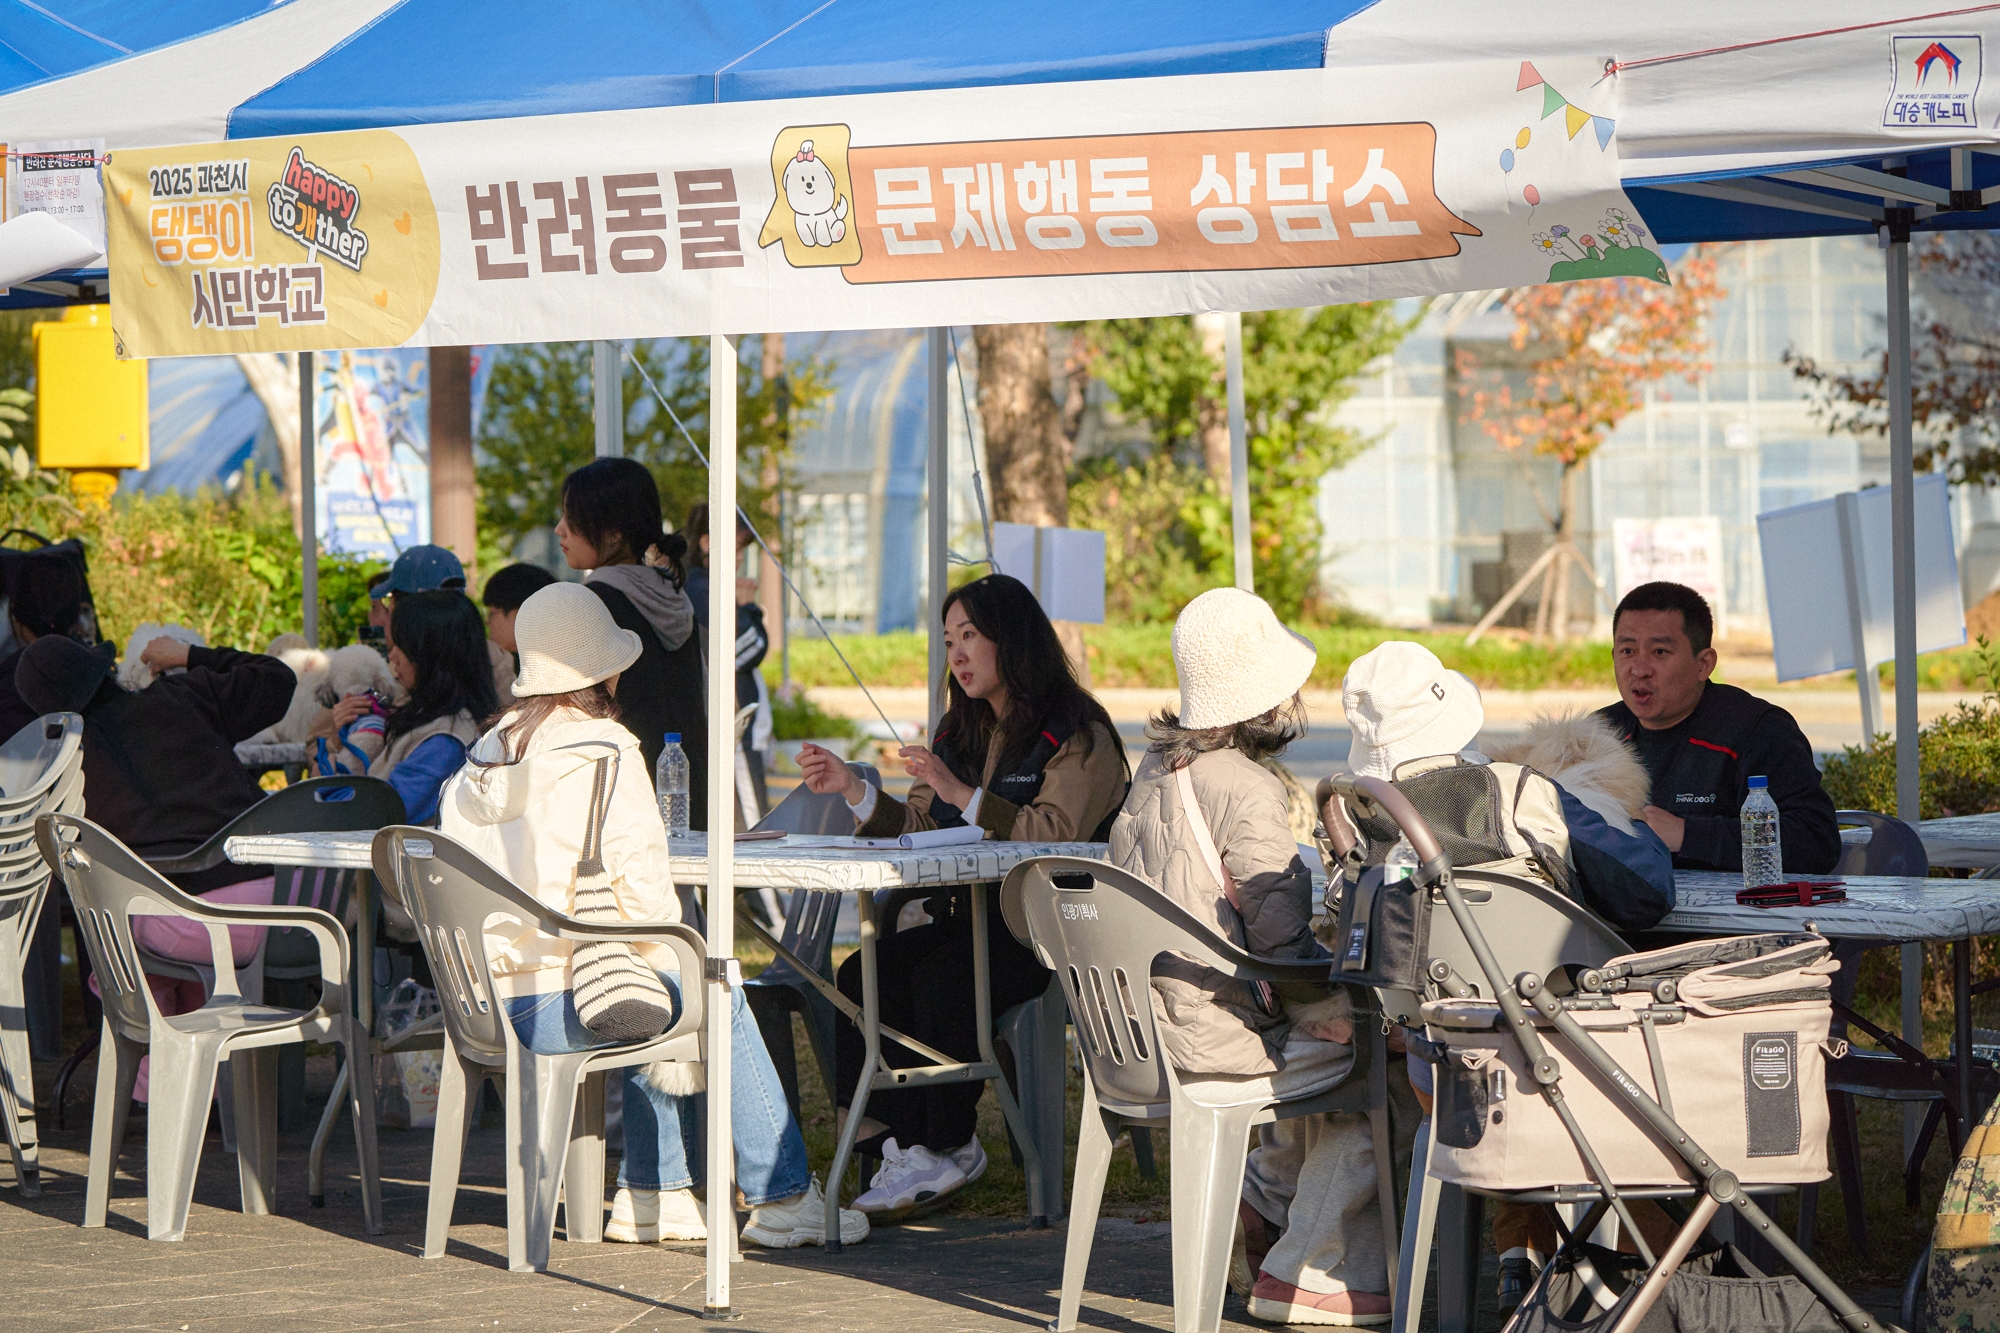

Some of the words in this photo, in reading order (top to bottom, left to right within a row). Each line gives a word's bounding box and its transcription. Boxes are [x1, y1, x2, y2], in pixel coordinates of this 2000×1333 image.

[1893, 102, 1967, 123] 대승캐노피
[70, 205, 84, 213] 17:00
[150, 167, 193, 197] 2025
[196, 161, 249, 193] 과천시
[285, 155, 357, 219] happy
[873, 155, 1160, 256] 문제행동
[1190, 148, 1423, 245] 상담소
[151, 200, 254, 263] 댕댕이
[271, 192, 366, 263] to개ther
[465, 167, 745, 281] 반려동물
[192, 265, 326, 328] 시민학교
[1430, 682, 1446, 701] C
[1613, 1069, 1640, 1098] FikaGO
